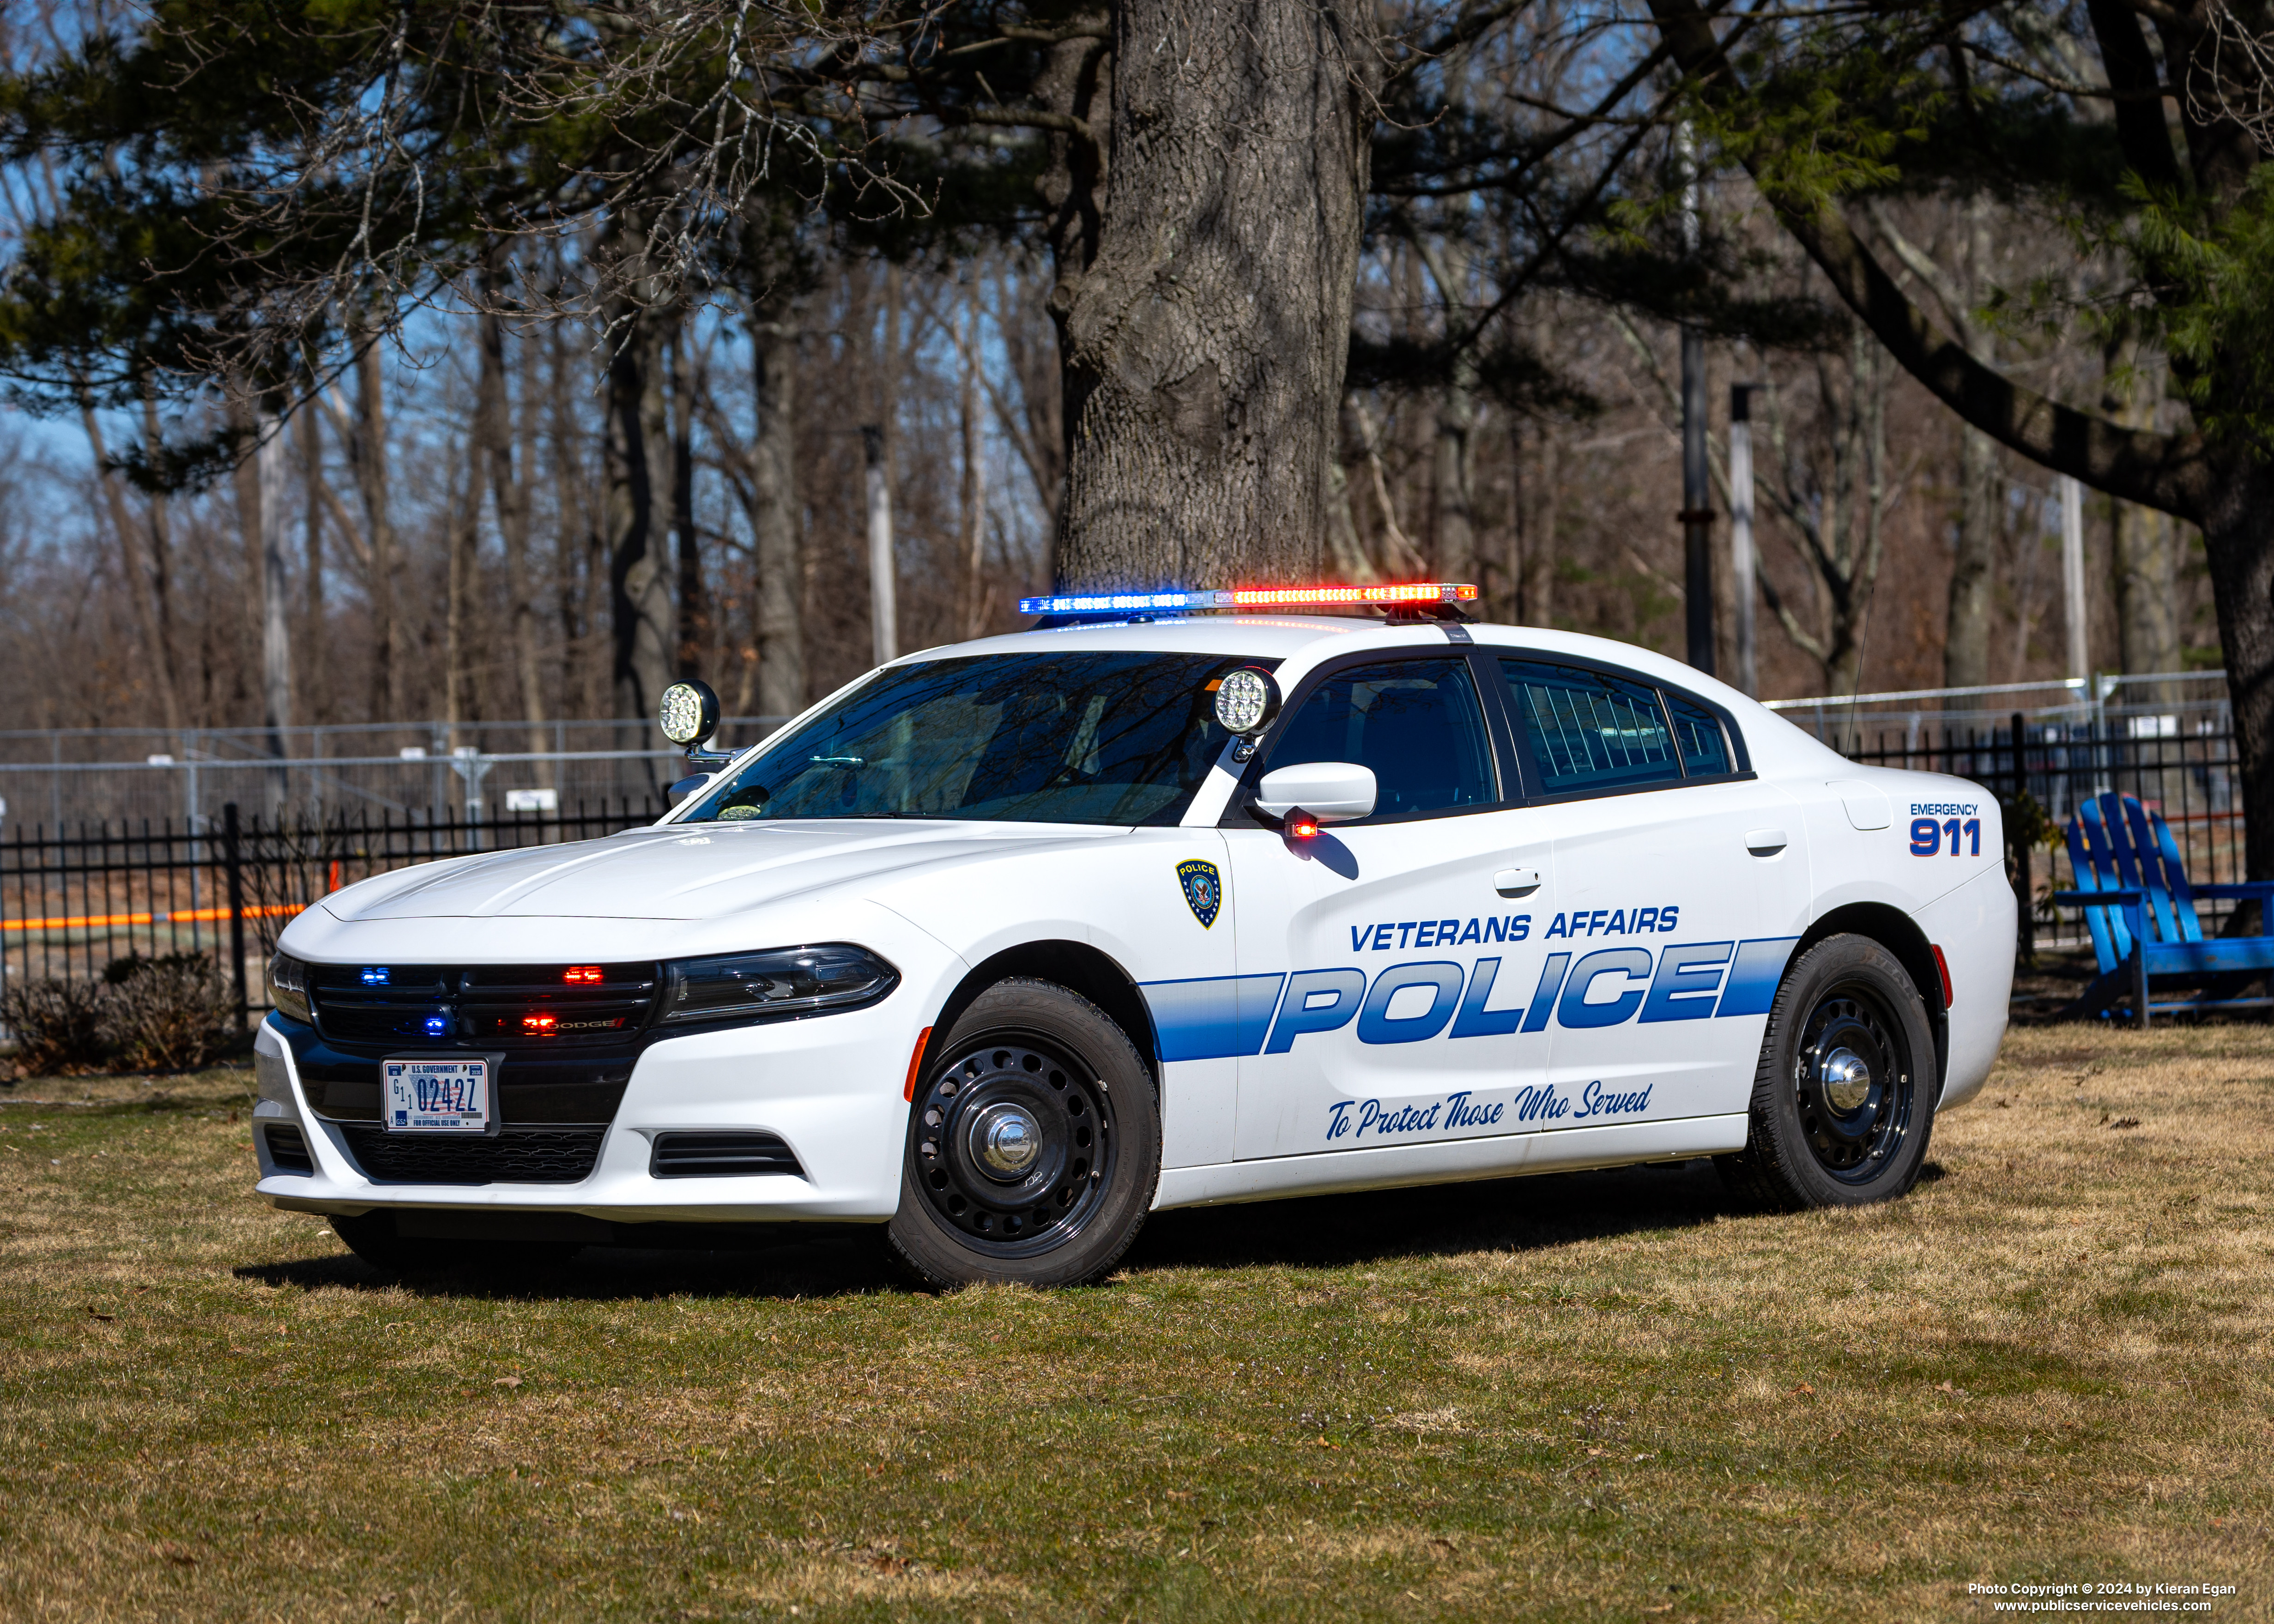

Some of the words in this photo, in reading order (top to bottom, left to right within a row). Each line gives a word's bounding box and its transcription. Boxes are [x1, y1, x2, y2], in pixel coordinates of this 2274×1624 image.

[1911, 804, 1978, 815] EMERGENCY
[1910, 818, 1980, 857] 911
[1179, 864, 1215, 876] POLICE
[1351, 914, 1532, 952] VETERANS
[1544, 906, 1680, 939] AFFAIRS
[1820, 949, 1915, 1000] GOODYEAR
[1264, 941, 1735, 1055] POLICE
[548, 1020, 616, 1029] DODGE
[412, 1065, 422, 1074] U.S.
[423, 1065, 458, 1074] GOVERNMENT
[417, 1078, 477, 1111] 0242Z
[1327, 1101, 1355, 1140] To
[1356, 1099, 1441, 1137] Protect
[1445, 1091, 1503, 1129] Those
[1515, 1084, 1570, 1121] Who
[1574, 1081, 1652, 1118] Served
[390, 1116, 393, 1124] A
